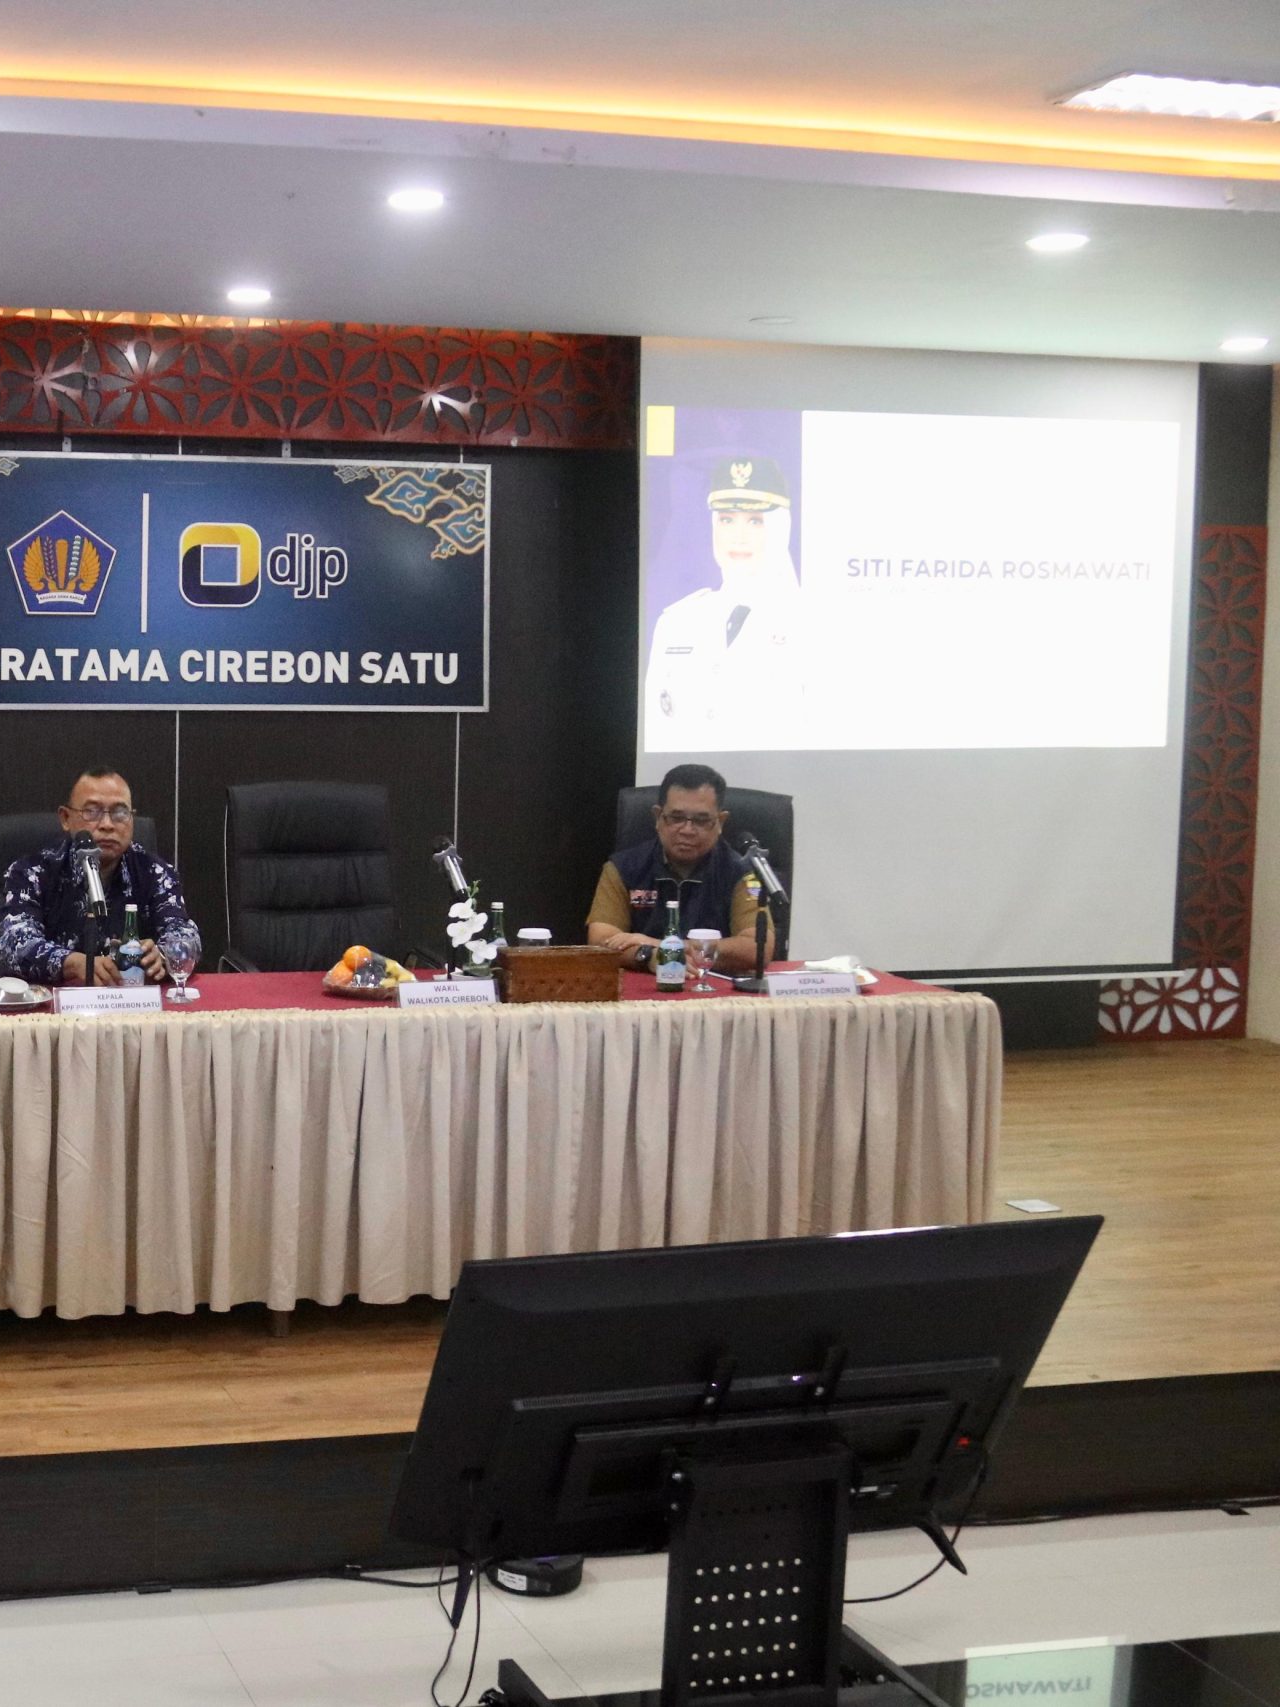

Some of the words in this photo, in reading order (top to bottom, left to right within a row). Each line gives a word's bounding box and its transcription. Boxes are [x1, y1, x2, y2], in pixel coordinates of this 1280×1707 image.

[267, 533, 349, 598] djp
[847, 558, 892, 578] SITI
[901, 559, 993, 580] FARIDA
[1003, 560, 1151, 581] ROSMAWATI
[180, 649, 350, 684] CIREBON
[359, 651, 460, 685] SATU
[407, 997, 451, 1005] WALIKOTA
[452, 995, 489, 1003] CIREBON
